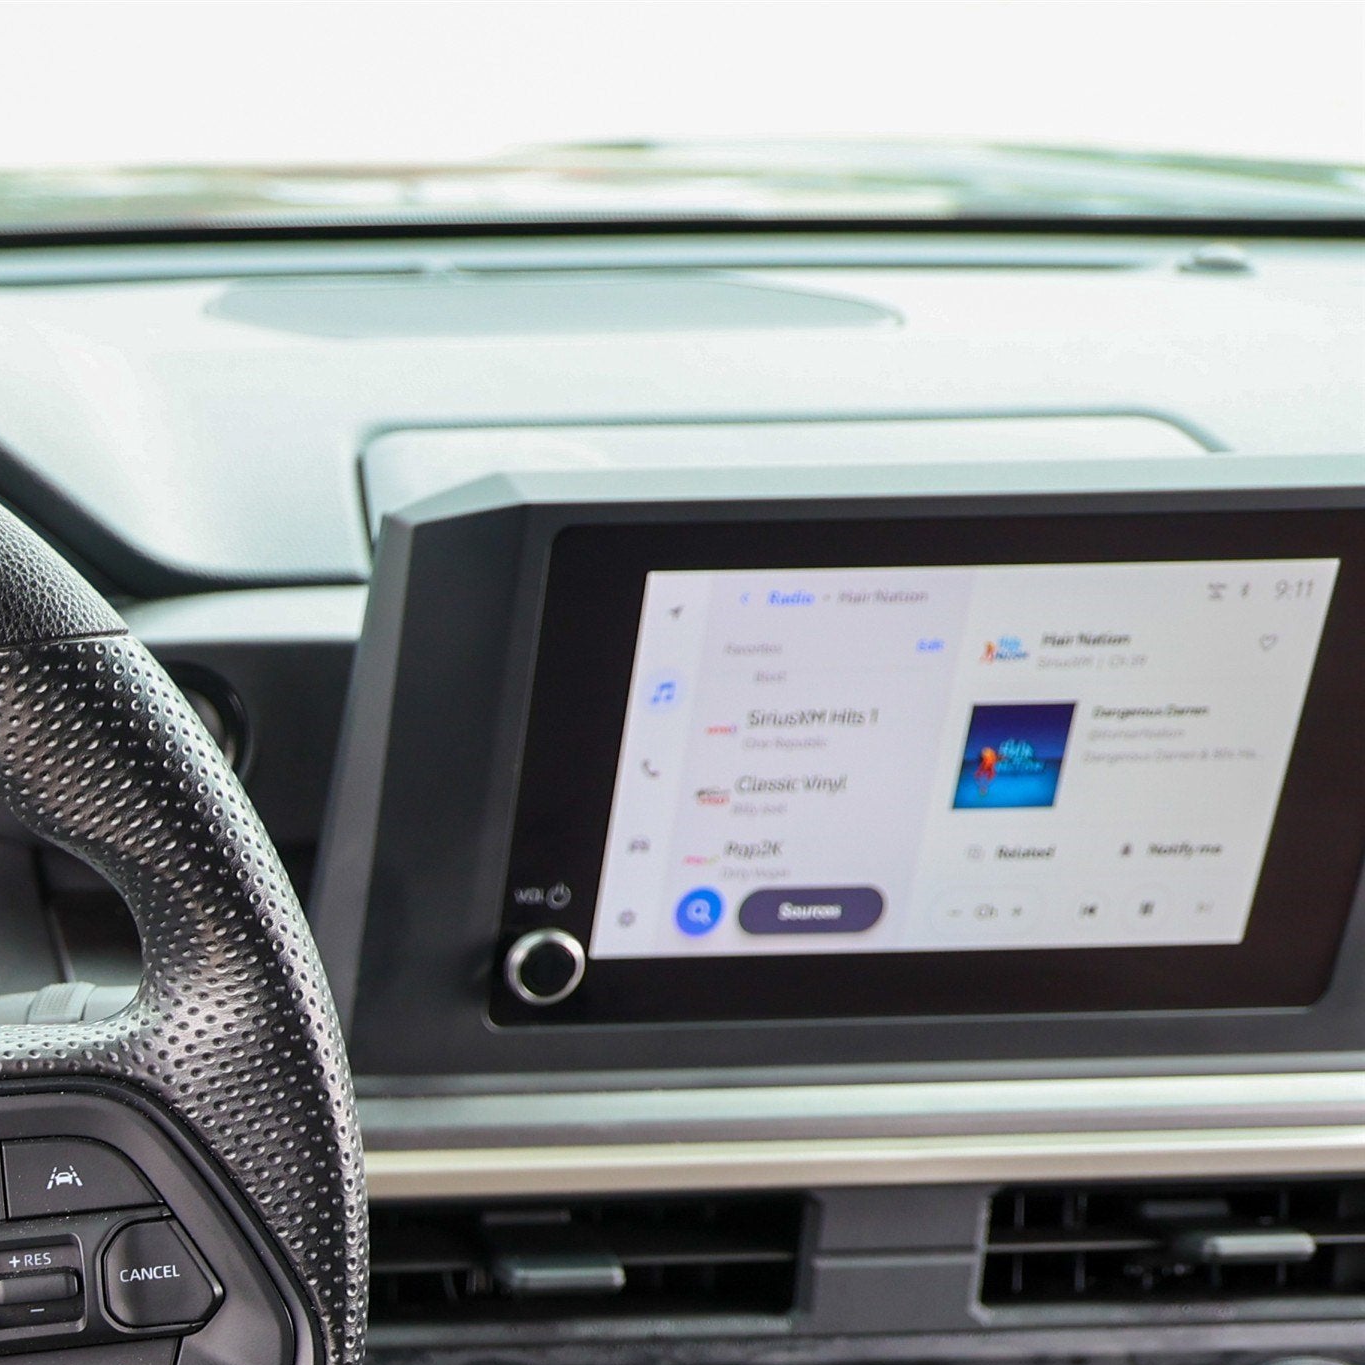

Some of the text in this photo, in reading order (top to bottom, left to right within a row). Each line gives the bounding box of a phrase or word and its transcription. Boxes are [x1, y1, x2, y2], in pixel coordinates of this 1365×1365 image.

[768, 590, 815, 604] Radio
[1274, 579, 1314, 597] 9:11
[734, 775, 796, 794] Classic
[119, 1263, 181, 1284] CANCEL
